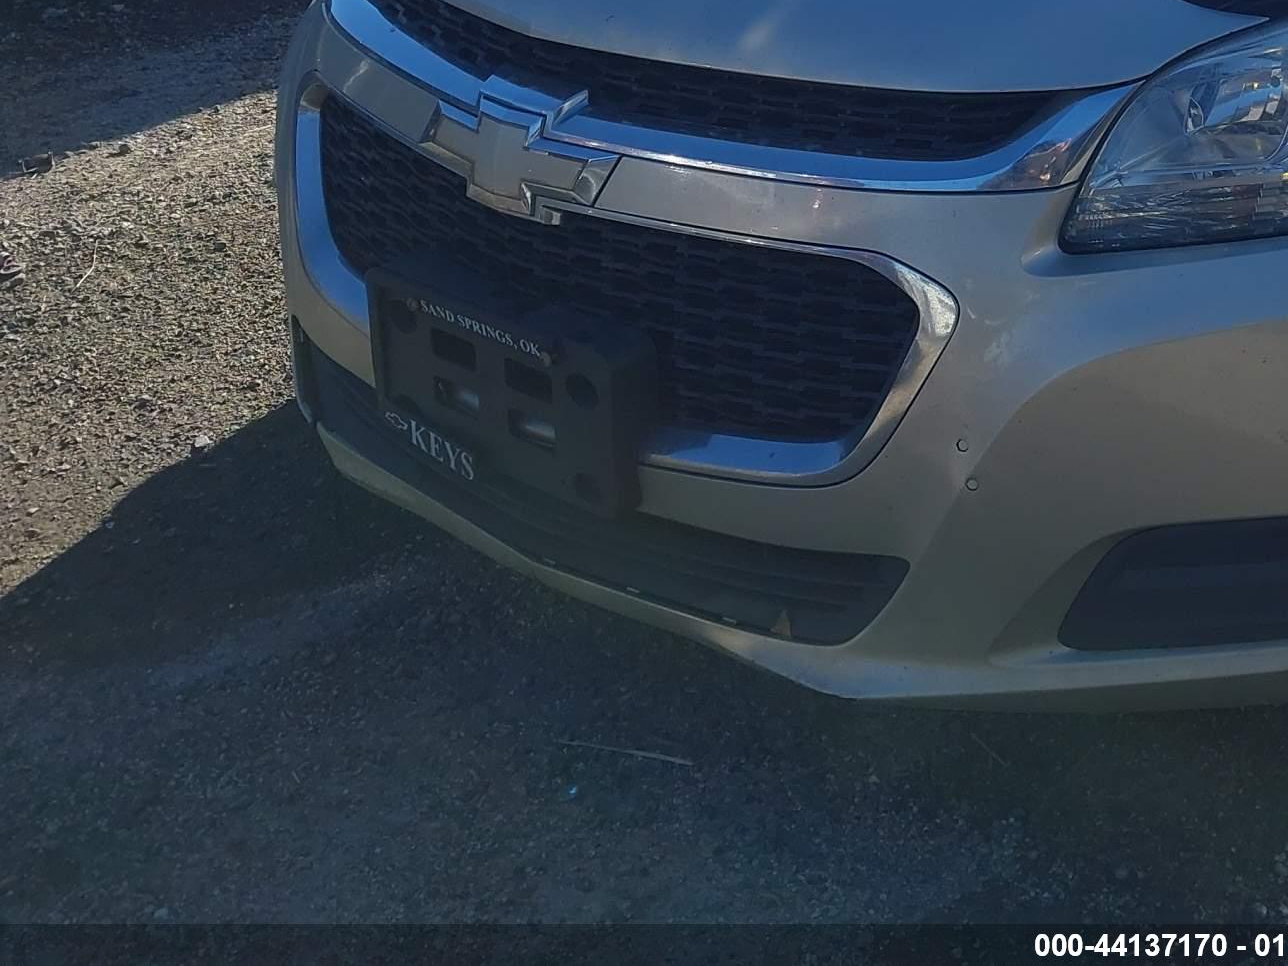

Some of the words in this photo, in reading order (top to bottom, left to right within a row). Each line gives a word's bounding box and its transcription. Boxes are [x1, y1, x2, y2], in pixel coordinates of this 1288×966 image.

[420, 299, 455, 324] SAND
[457, 314, 519, 350] SPRINGS,
[519, 338, 541, 357] OK
[408, 419, 475, 481] KEYS
